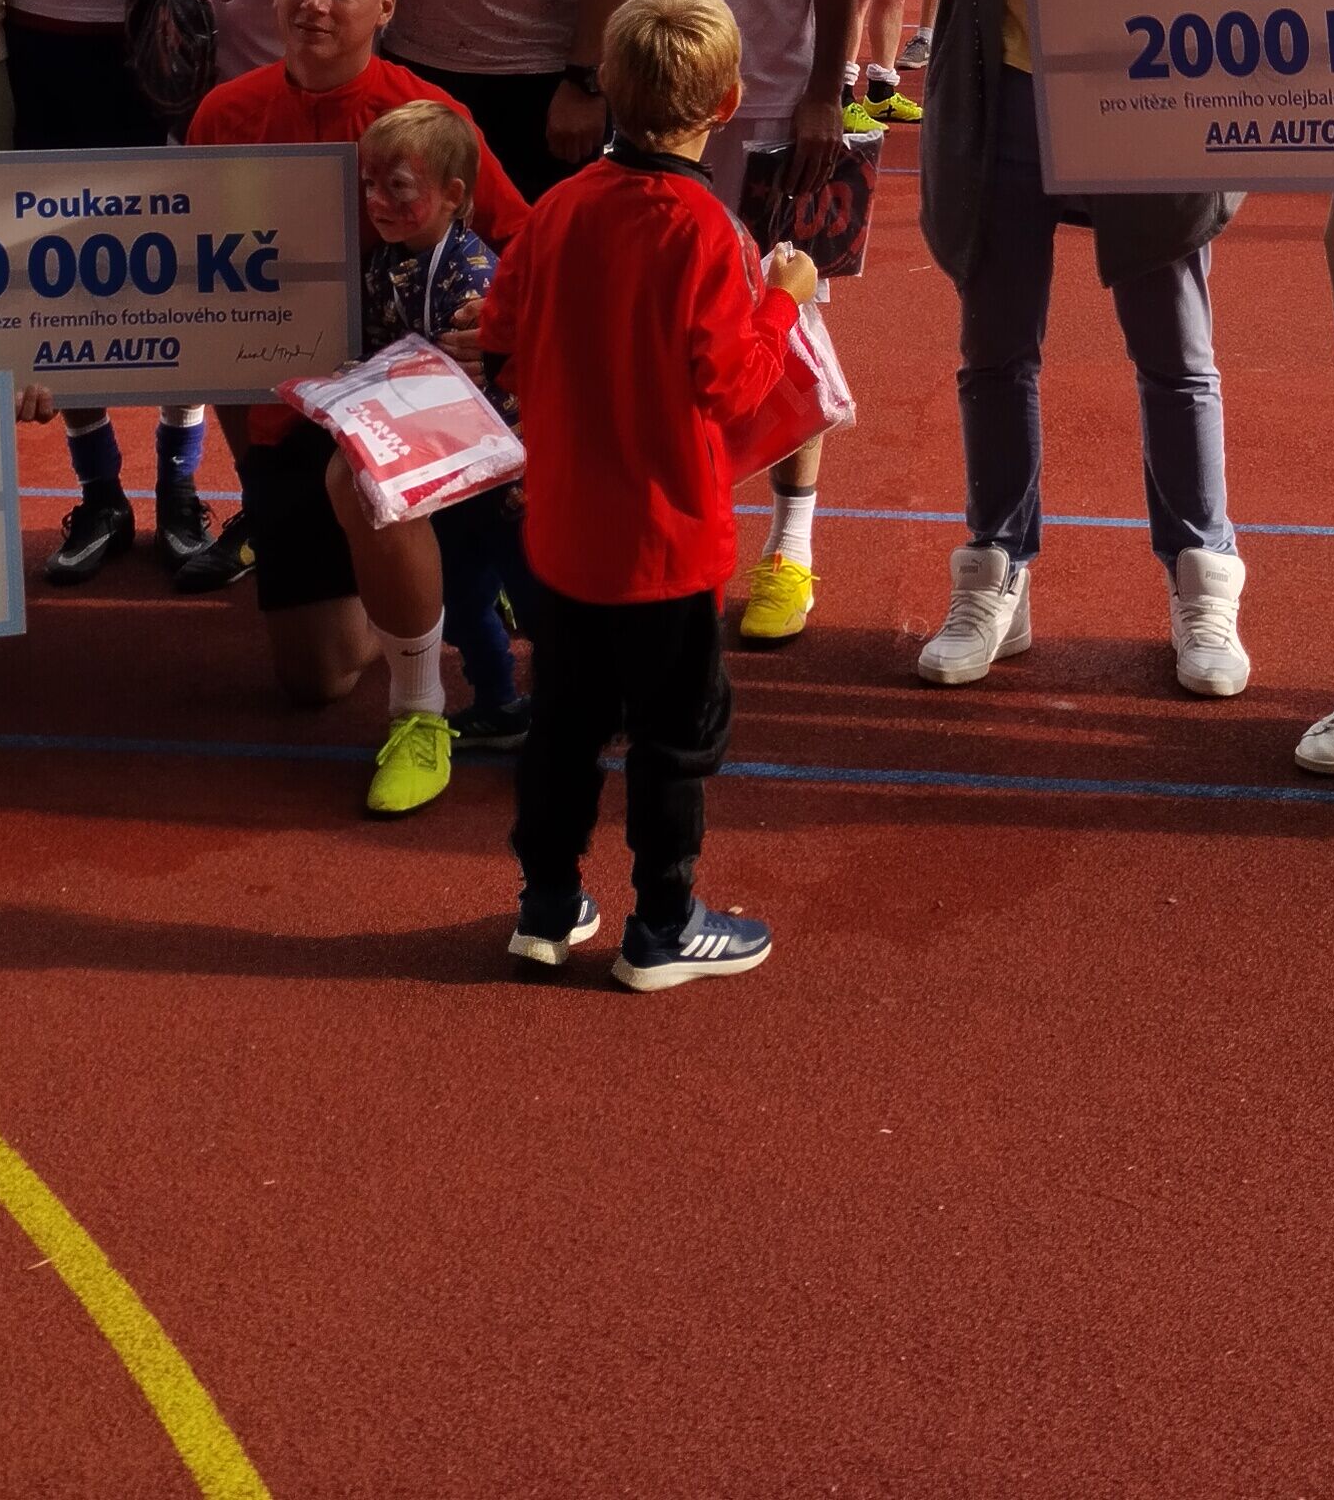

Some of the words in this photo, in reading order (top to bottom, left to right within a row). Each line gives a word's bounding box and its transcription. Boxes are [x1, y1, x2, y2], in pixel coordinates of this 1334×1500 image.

[1124, 8, 1310, 81] 2000
[1099, 97, 1128, 116] pro
[1130, 93, 1177, 112] vítěze
[1184, 89, 1265, 109] firemního
[1206, 120, 1262, 146] AAA
[14, 188, 142, 219] Poukaz
[149, 190, 191, 216] na
[27, 231, 179, 300] 000
[196, 228, 281, 295] Kč
[29, 308, 117, 329] firemního
[121, 306, 227, 326] fotbalového
[230, 306, 293, 326] turnaje
[34, 340, 95, 365] AAA
[105, 336, 181, 363] AUTO
